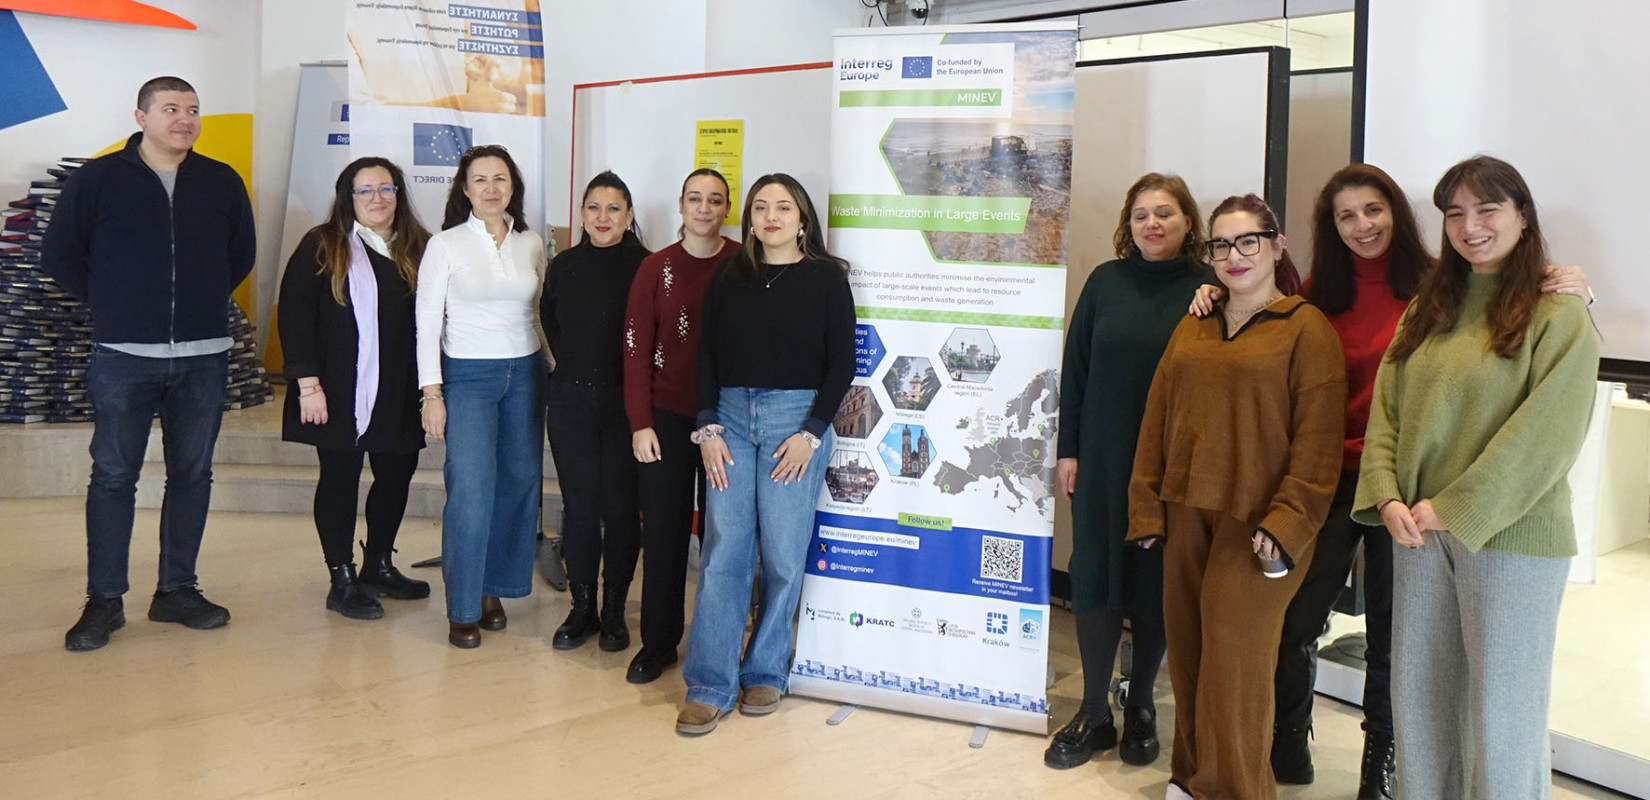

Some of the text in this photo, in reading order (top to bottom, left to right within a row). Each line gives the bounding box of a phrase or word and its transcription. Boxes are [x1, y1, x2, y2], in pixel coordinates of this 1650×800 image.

[840, 58, 892, 70] Interreg
[840, 71, 880, 82] Europe
[958, 93, 996, 103] MINEV
[831, 206, 1021, 222] Waste Minimization in Large Events
[876, 294, 919, 302] consumption
[856, 357, 871, 366] ning
[908, 516, 930, 525] Follow
[820, 529, 917, 546] www.interregeurope.eu/minev
[831, 546, 879, 557] @InterregMINEV
[972, 578, 991, 586] Receive
[866, 618, 895, 628] KRATC
[982, 638, 1010, 647] Kraków
